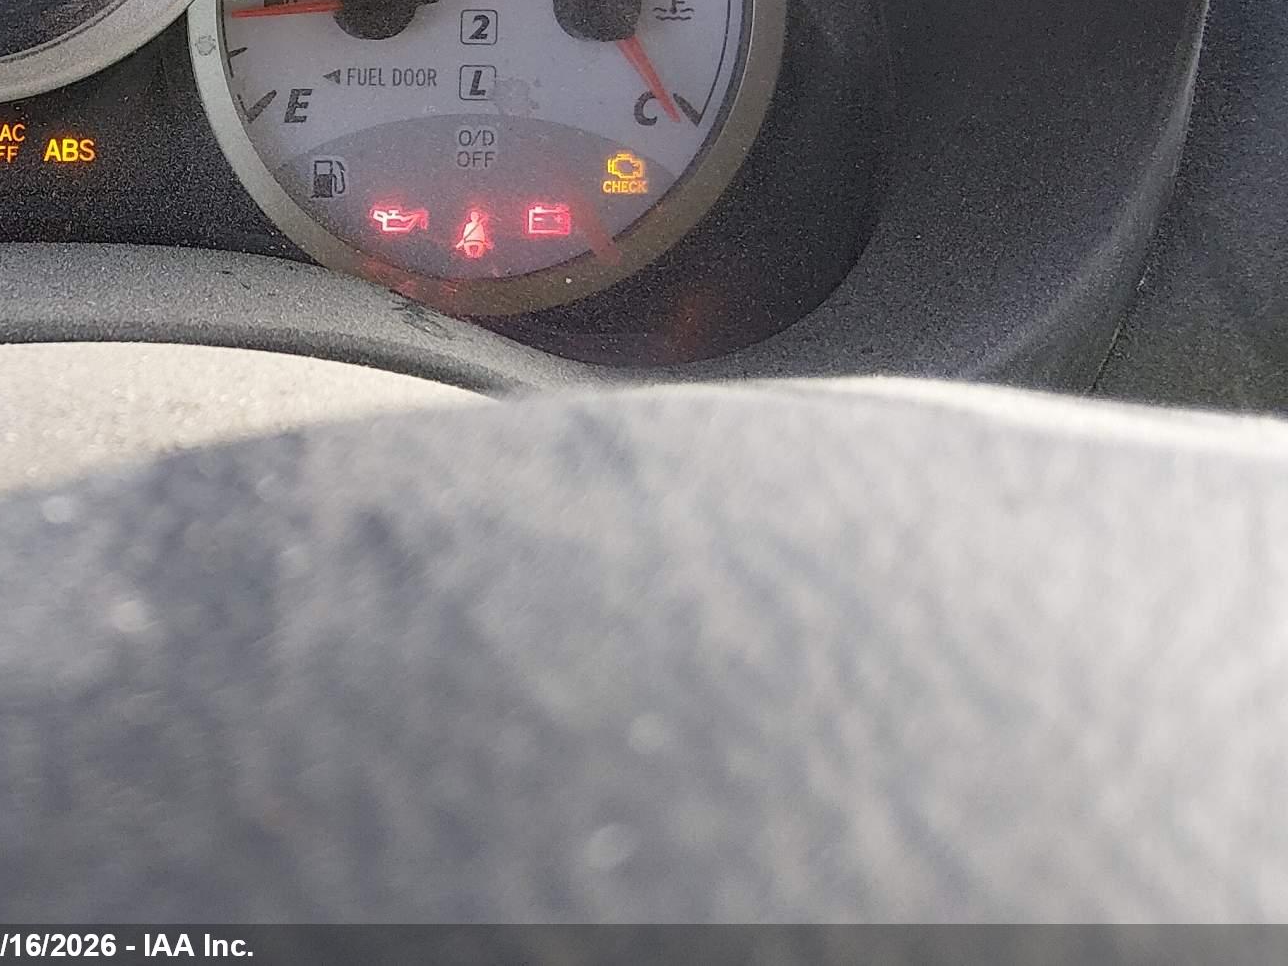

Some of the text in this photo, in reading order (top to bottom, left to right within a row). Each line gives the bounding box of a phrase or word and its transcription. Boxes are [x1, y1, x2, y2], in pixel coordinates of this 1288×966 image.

[470, 14, 490, 40] 2
[346, 67, 438, 87] FUEL DOOR
[470, 70, 488, 95] L
[283, 88, 314, 124] E
[632, 90, 662, 127] C
[43, 138, 96, 162] ABS
[458, 129, 496, 148] O/D
[456, 151, 495, 168] OFF
[602, 179, 648, 194] CHECK
